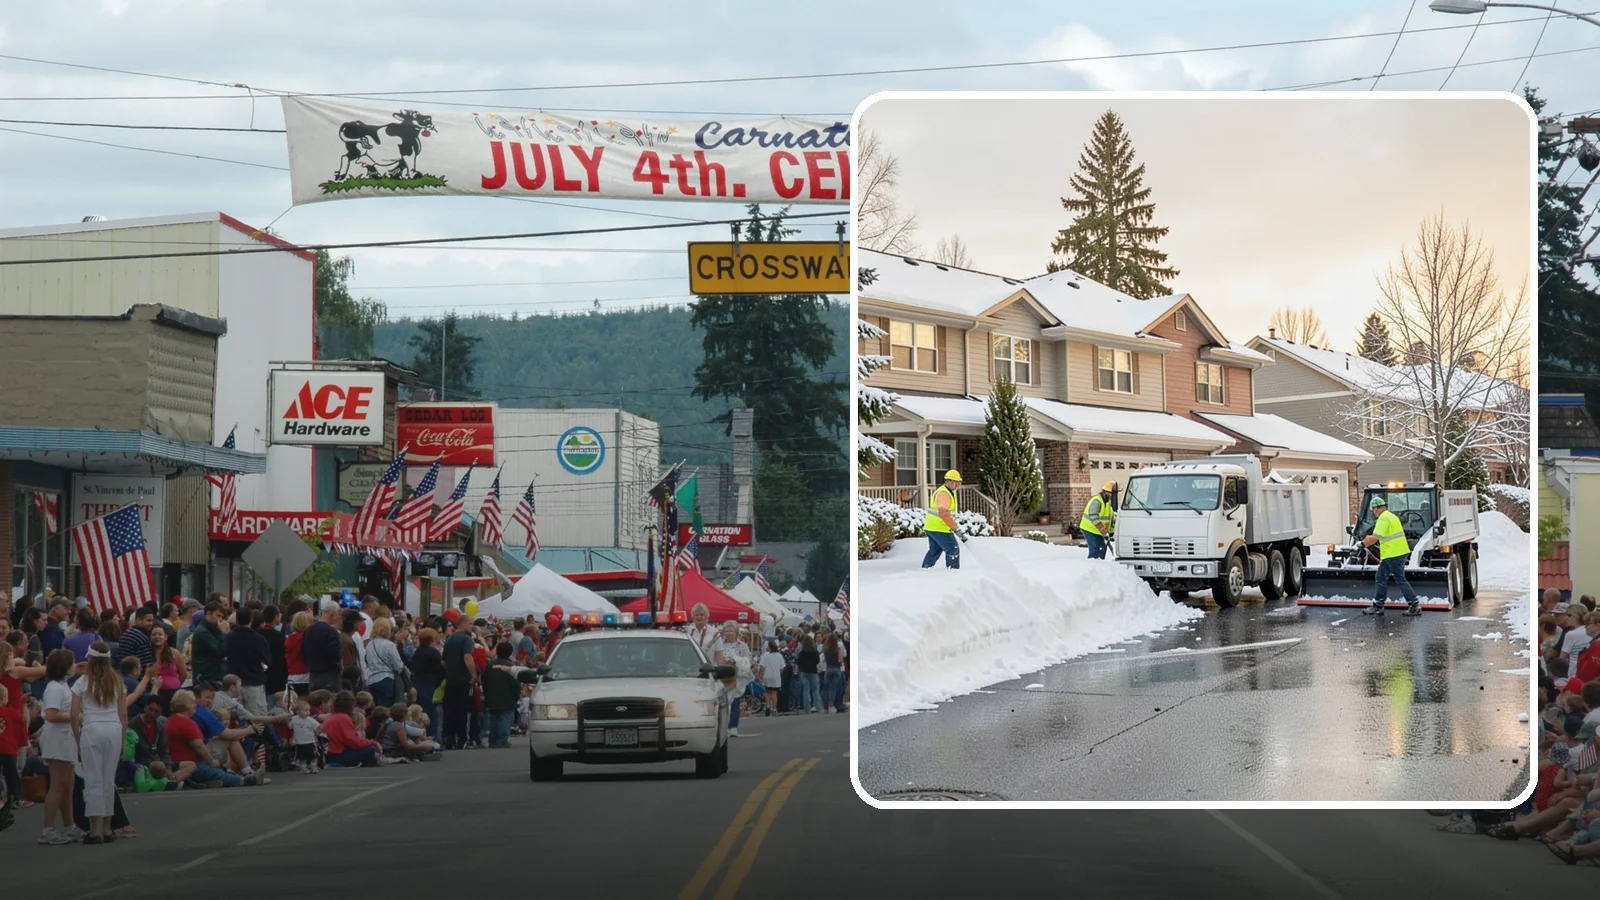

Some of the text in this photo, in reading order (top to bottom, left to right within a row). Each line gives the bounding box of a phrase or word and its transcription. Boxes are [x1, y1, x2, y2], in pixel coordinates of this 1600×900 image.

[481, 141, 605, 192] JULY
[632, 150, 746, 198] 4th.
[697, 254, 850, 280] CROSSWA
[282, 380, 373, 420] ACE
[405, 409, 453, 422] CEDAR
[283, 421, 370, 436] Hardware
[353, 467, 384, 480] Simpl
[95, 484, 124, 495] Vincent
[125, 485, 136, 495] de
[138, 486, 155, 495] Paul
[81, 503, 154, 522] THT
[688, 526, 741, 535] CRNATION
[699, 535, 730, 543] GLASS
